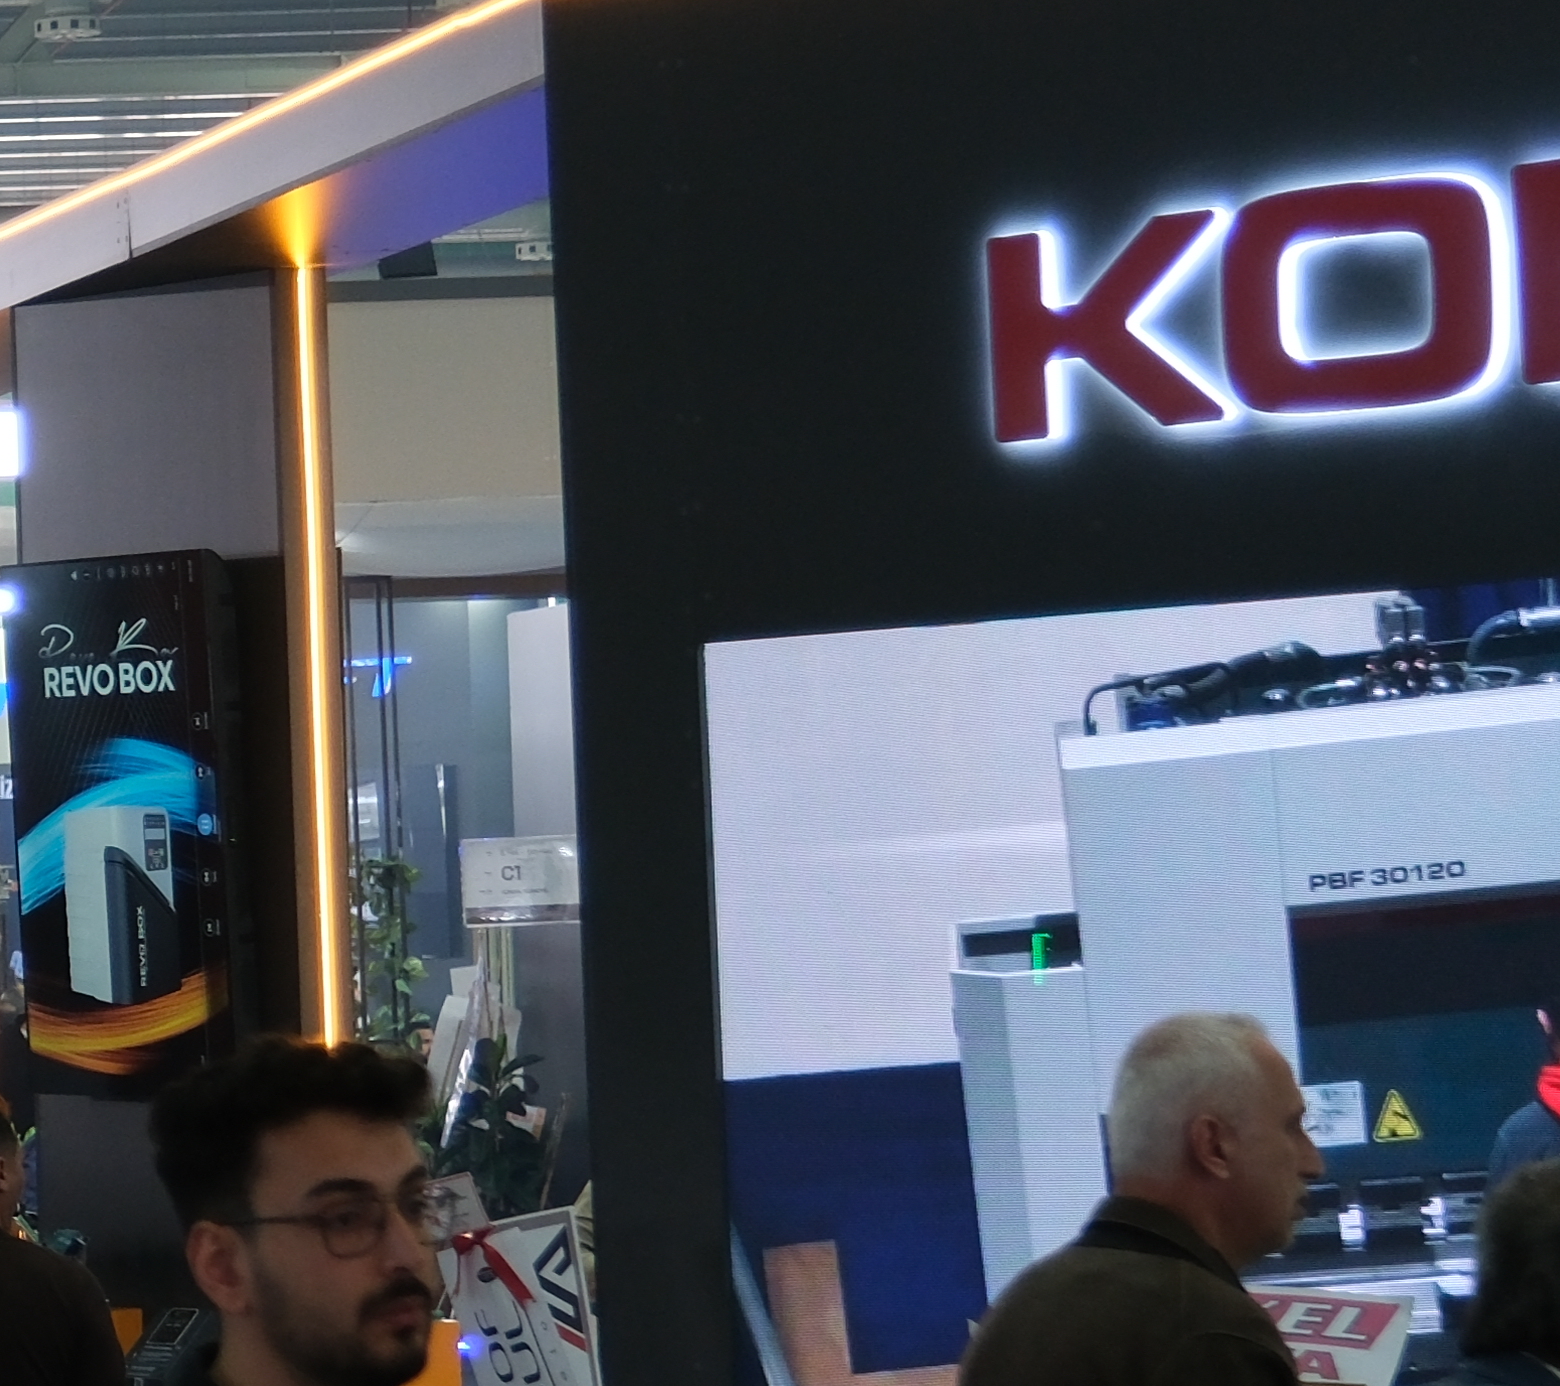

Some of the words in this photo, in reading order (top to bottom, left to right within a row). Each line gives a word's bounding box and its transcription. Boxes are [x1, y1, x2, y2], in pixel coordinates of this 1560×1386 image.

[43, 663, 115, 699] REVO
[118, 659, 176, 695] BOX
[501, 864, 522, 881] C1
[1308, 869, 1365, 893] PBF
[1370, 860, 1465, 887] 30120
